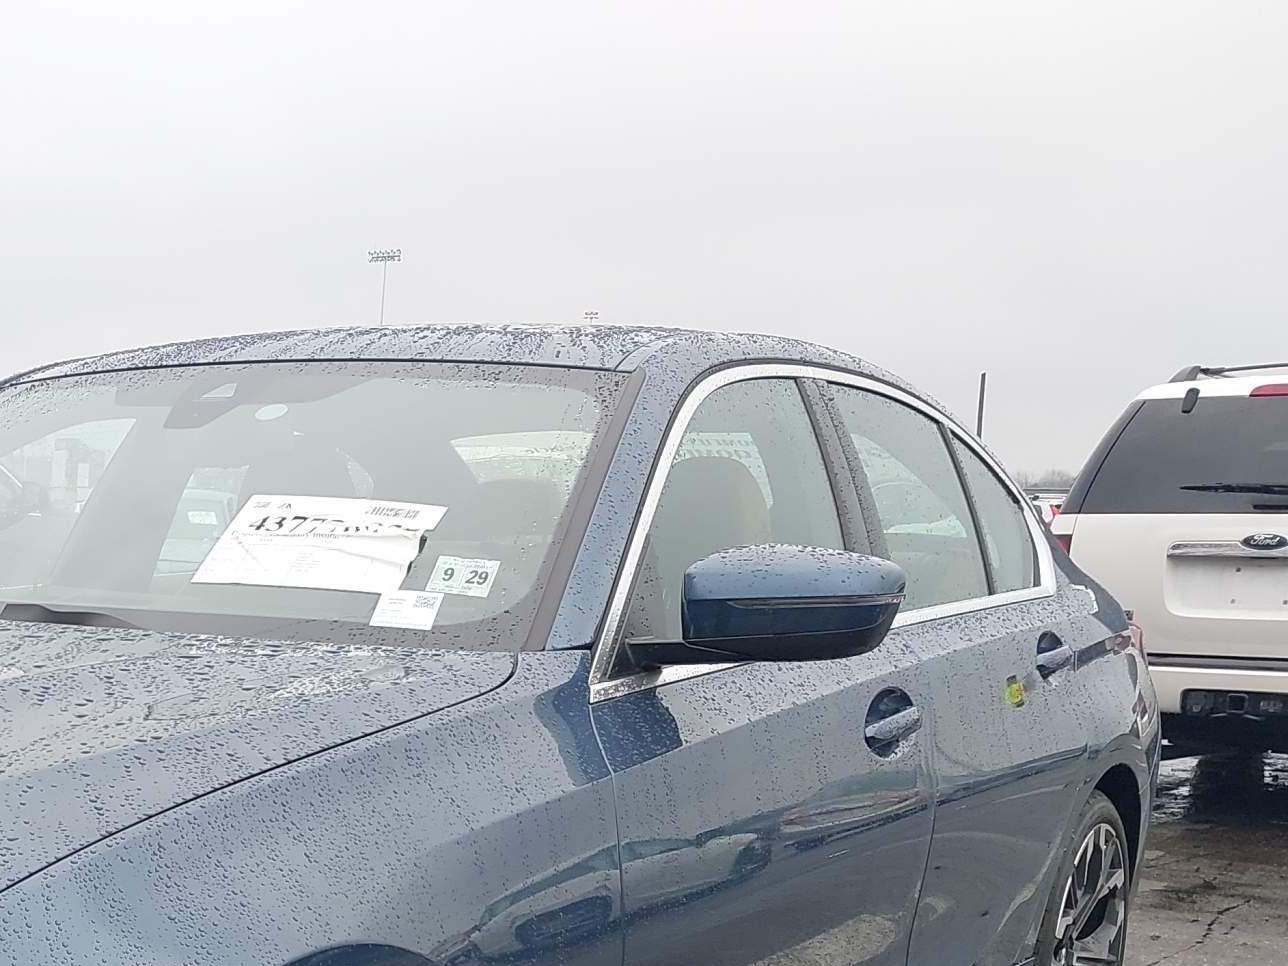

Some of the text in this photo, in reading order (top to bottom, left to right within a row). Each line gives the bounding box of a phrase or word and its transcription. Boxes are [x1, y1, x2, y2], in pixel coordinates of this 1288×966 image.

[1250, 534, 1280, 546] Ford
[441, 567, 490, 586] 9 29
